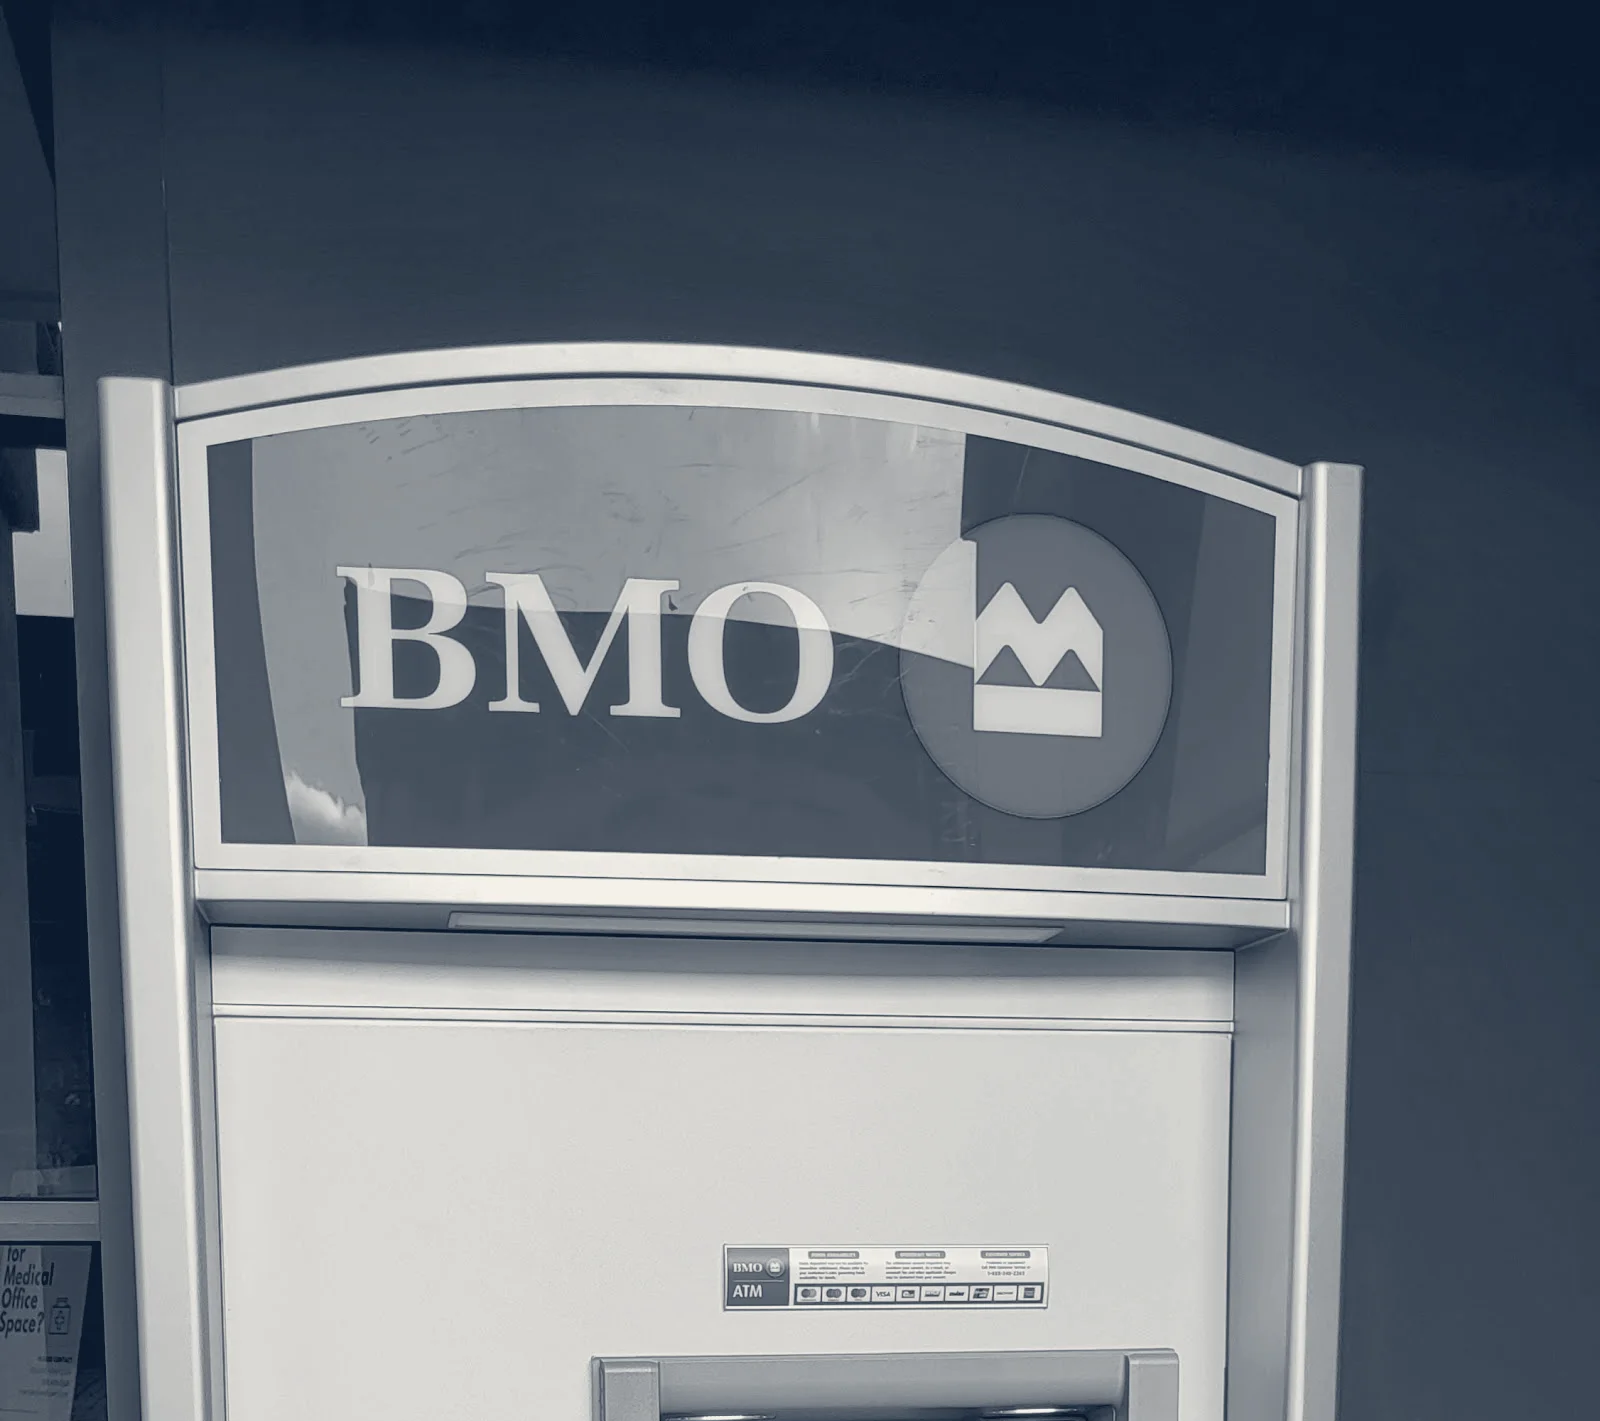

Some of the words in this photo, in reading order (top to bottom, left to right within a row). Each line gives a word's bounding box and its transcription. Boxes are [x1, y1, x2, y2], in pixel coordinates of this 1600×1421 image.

[336, 564, 834, 724] BMO
[7, 1246, 26, 1263] for
[3, 1262, 55, 1286] Medical
[733, 1262, 763, 1273] BMO
[1, 1286, 38, 1309] Office
[732, 1284, 763, 1298] ATM
[876, 1290, 891, 1298] VISA
[0, 1311, 45, 1339] Space?
